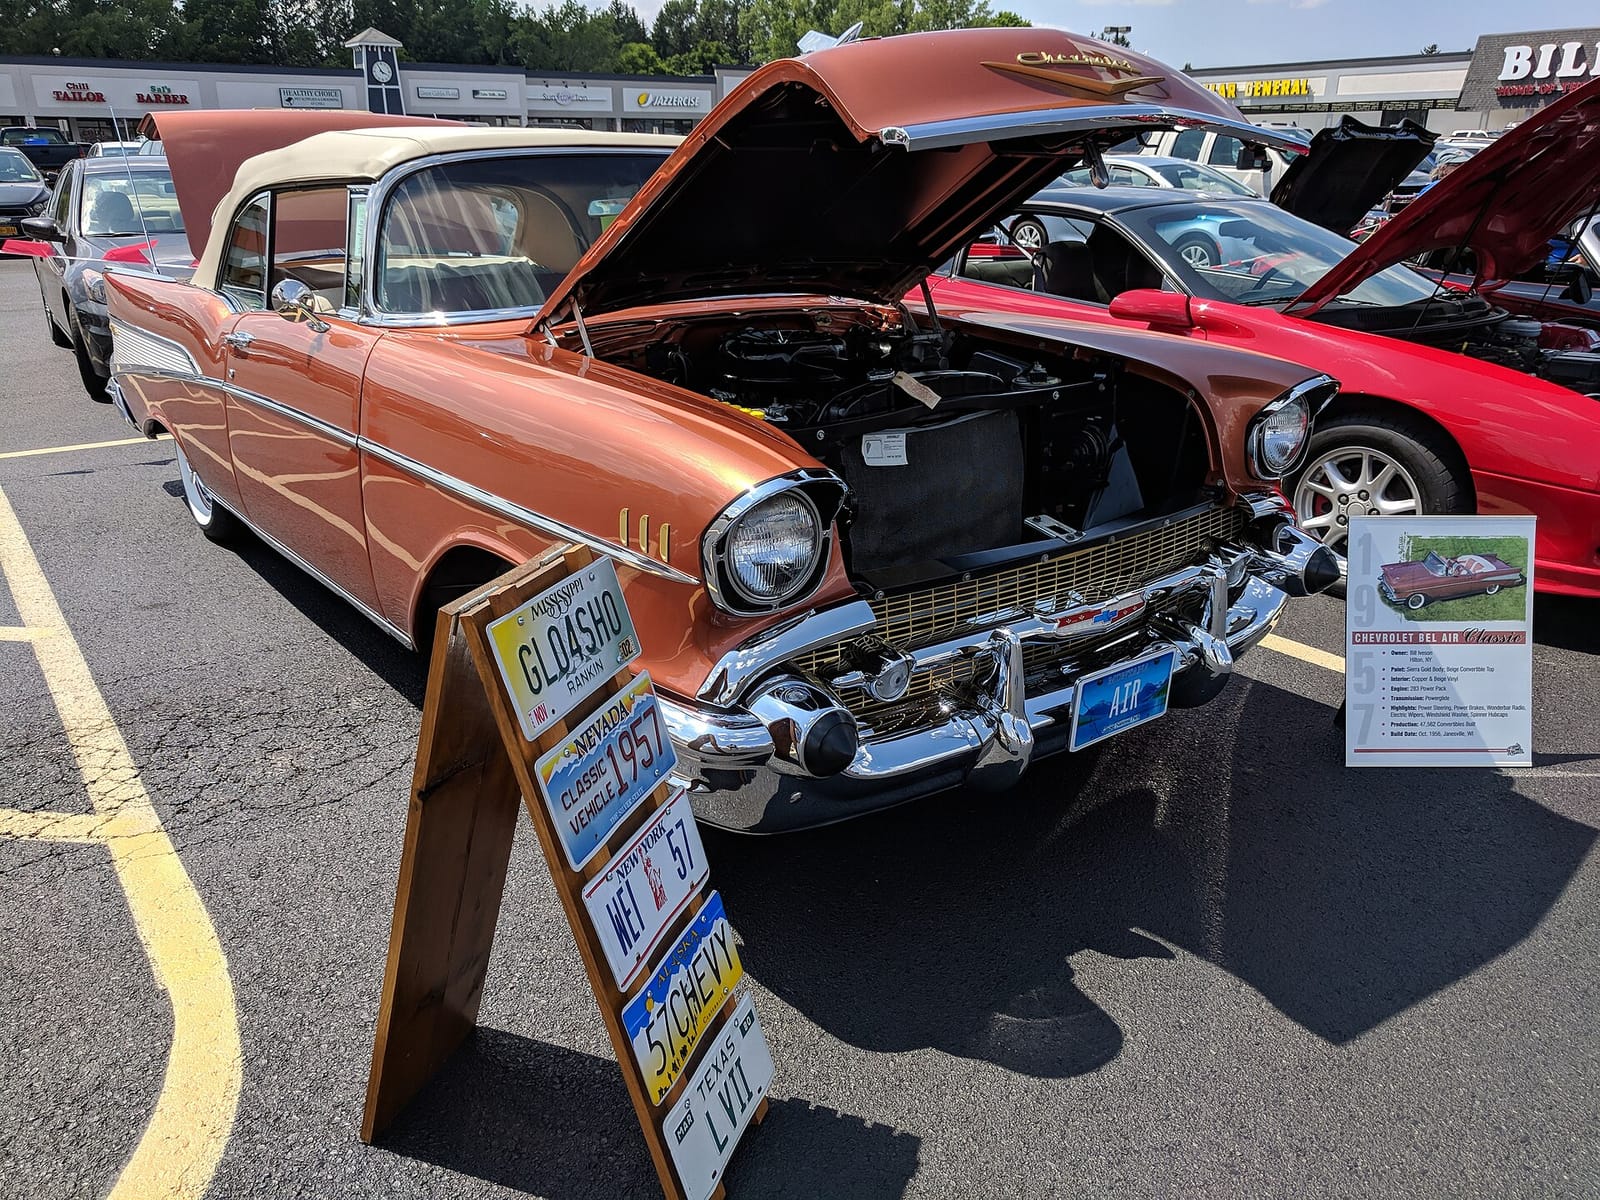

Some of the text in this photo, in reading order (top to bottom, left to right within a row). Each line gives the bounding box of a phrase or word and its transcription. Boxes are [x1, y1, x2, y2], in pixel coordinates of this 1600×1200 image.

[53, 91, 106, 102] TAILOR
[66, 82, 89, 90] Chill
[136, 93, 189, 104] BARBER
[150, 85, 171, 93] Sal's
[653, 95, 700, 107] JAZZERCISE
[1245, 79, 1309, 97] GENERAL
[1495, 84, 1535, 96] HOME
[1539, 82, 1557, 95] OF
[530, 577, 584, 621] MISSISSIPPI
[621, 640, 633, 657] 02
[1355, 627, 1523, 644] CHEVROLET BEL AIR Classic
[567, 658, 604, 695] RANKIN
[533, 702, 549, 725] NOV
[1109, 679, 1141, 719] AIR
[573, 700, 629, 760] NEVADA
[606, 705, 663, 797] 1957
[560, 758, 607, 811] CLASSIC
[569, 782, 616, 836] VEHICLE
[615, 820, 667, 884] NEW YORK
[666, 817, 694, 881] 57
[657, 929, 699, 988] ALASKA
[645, 922, 733, 1076] 57CHEVY
[696, 1035, 736, 1101] TEXAS
[705, 1055, 753, 1155] LVII
[676, 1113, 694, 1140] MAR
